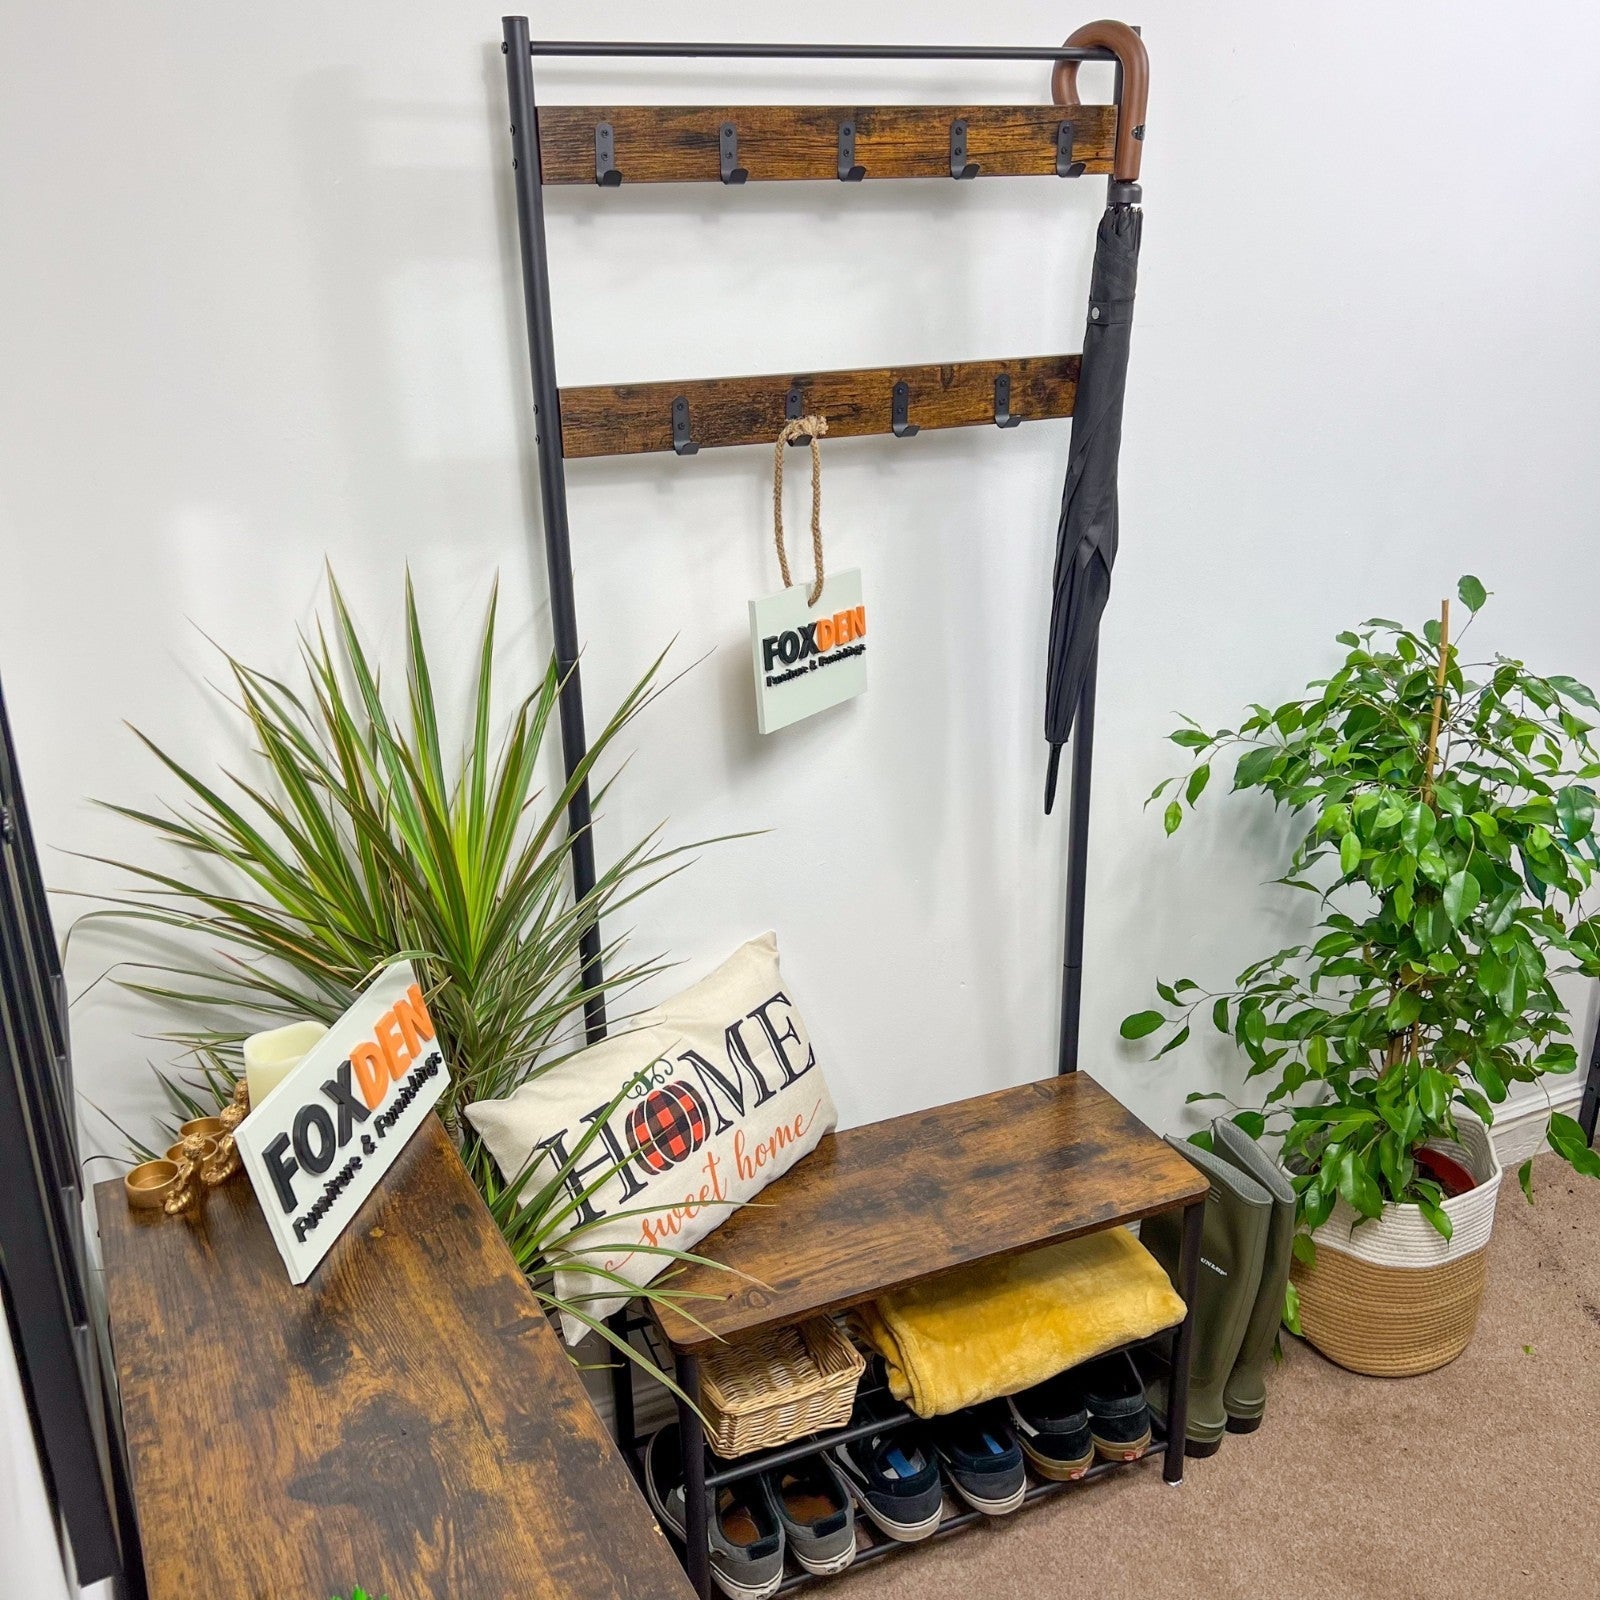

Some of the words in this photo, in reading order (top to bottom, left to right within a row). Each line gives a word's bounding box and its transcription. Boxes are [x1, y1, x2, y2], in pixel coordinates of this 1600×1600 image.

[763, 606, 866, 671] FOXDEN
[809, 659, 818, 671] &
[262, 983, 435, 1214] FOXDEN
[292, 1156, 363, 1243] Furniture
[360, 1134, 378, 1156] &
[605, 1151, 728, 1274] sweet
[733, 1098, 823, 1181] home
[1200, 1257, 1227, 1275] UNLOP
